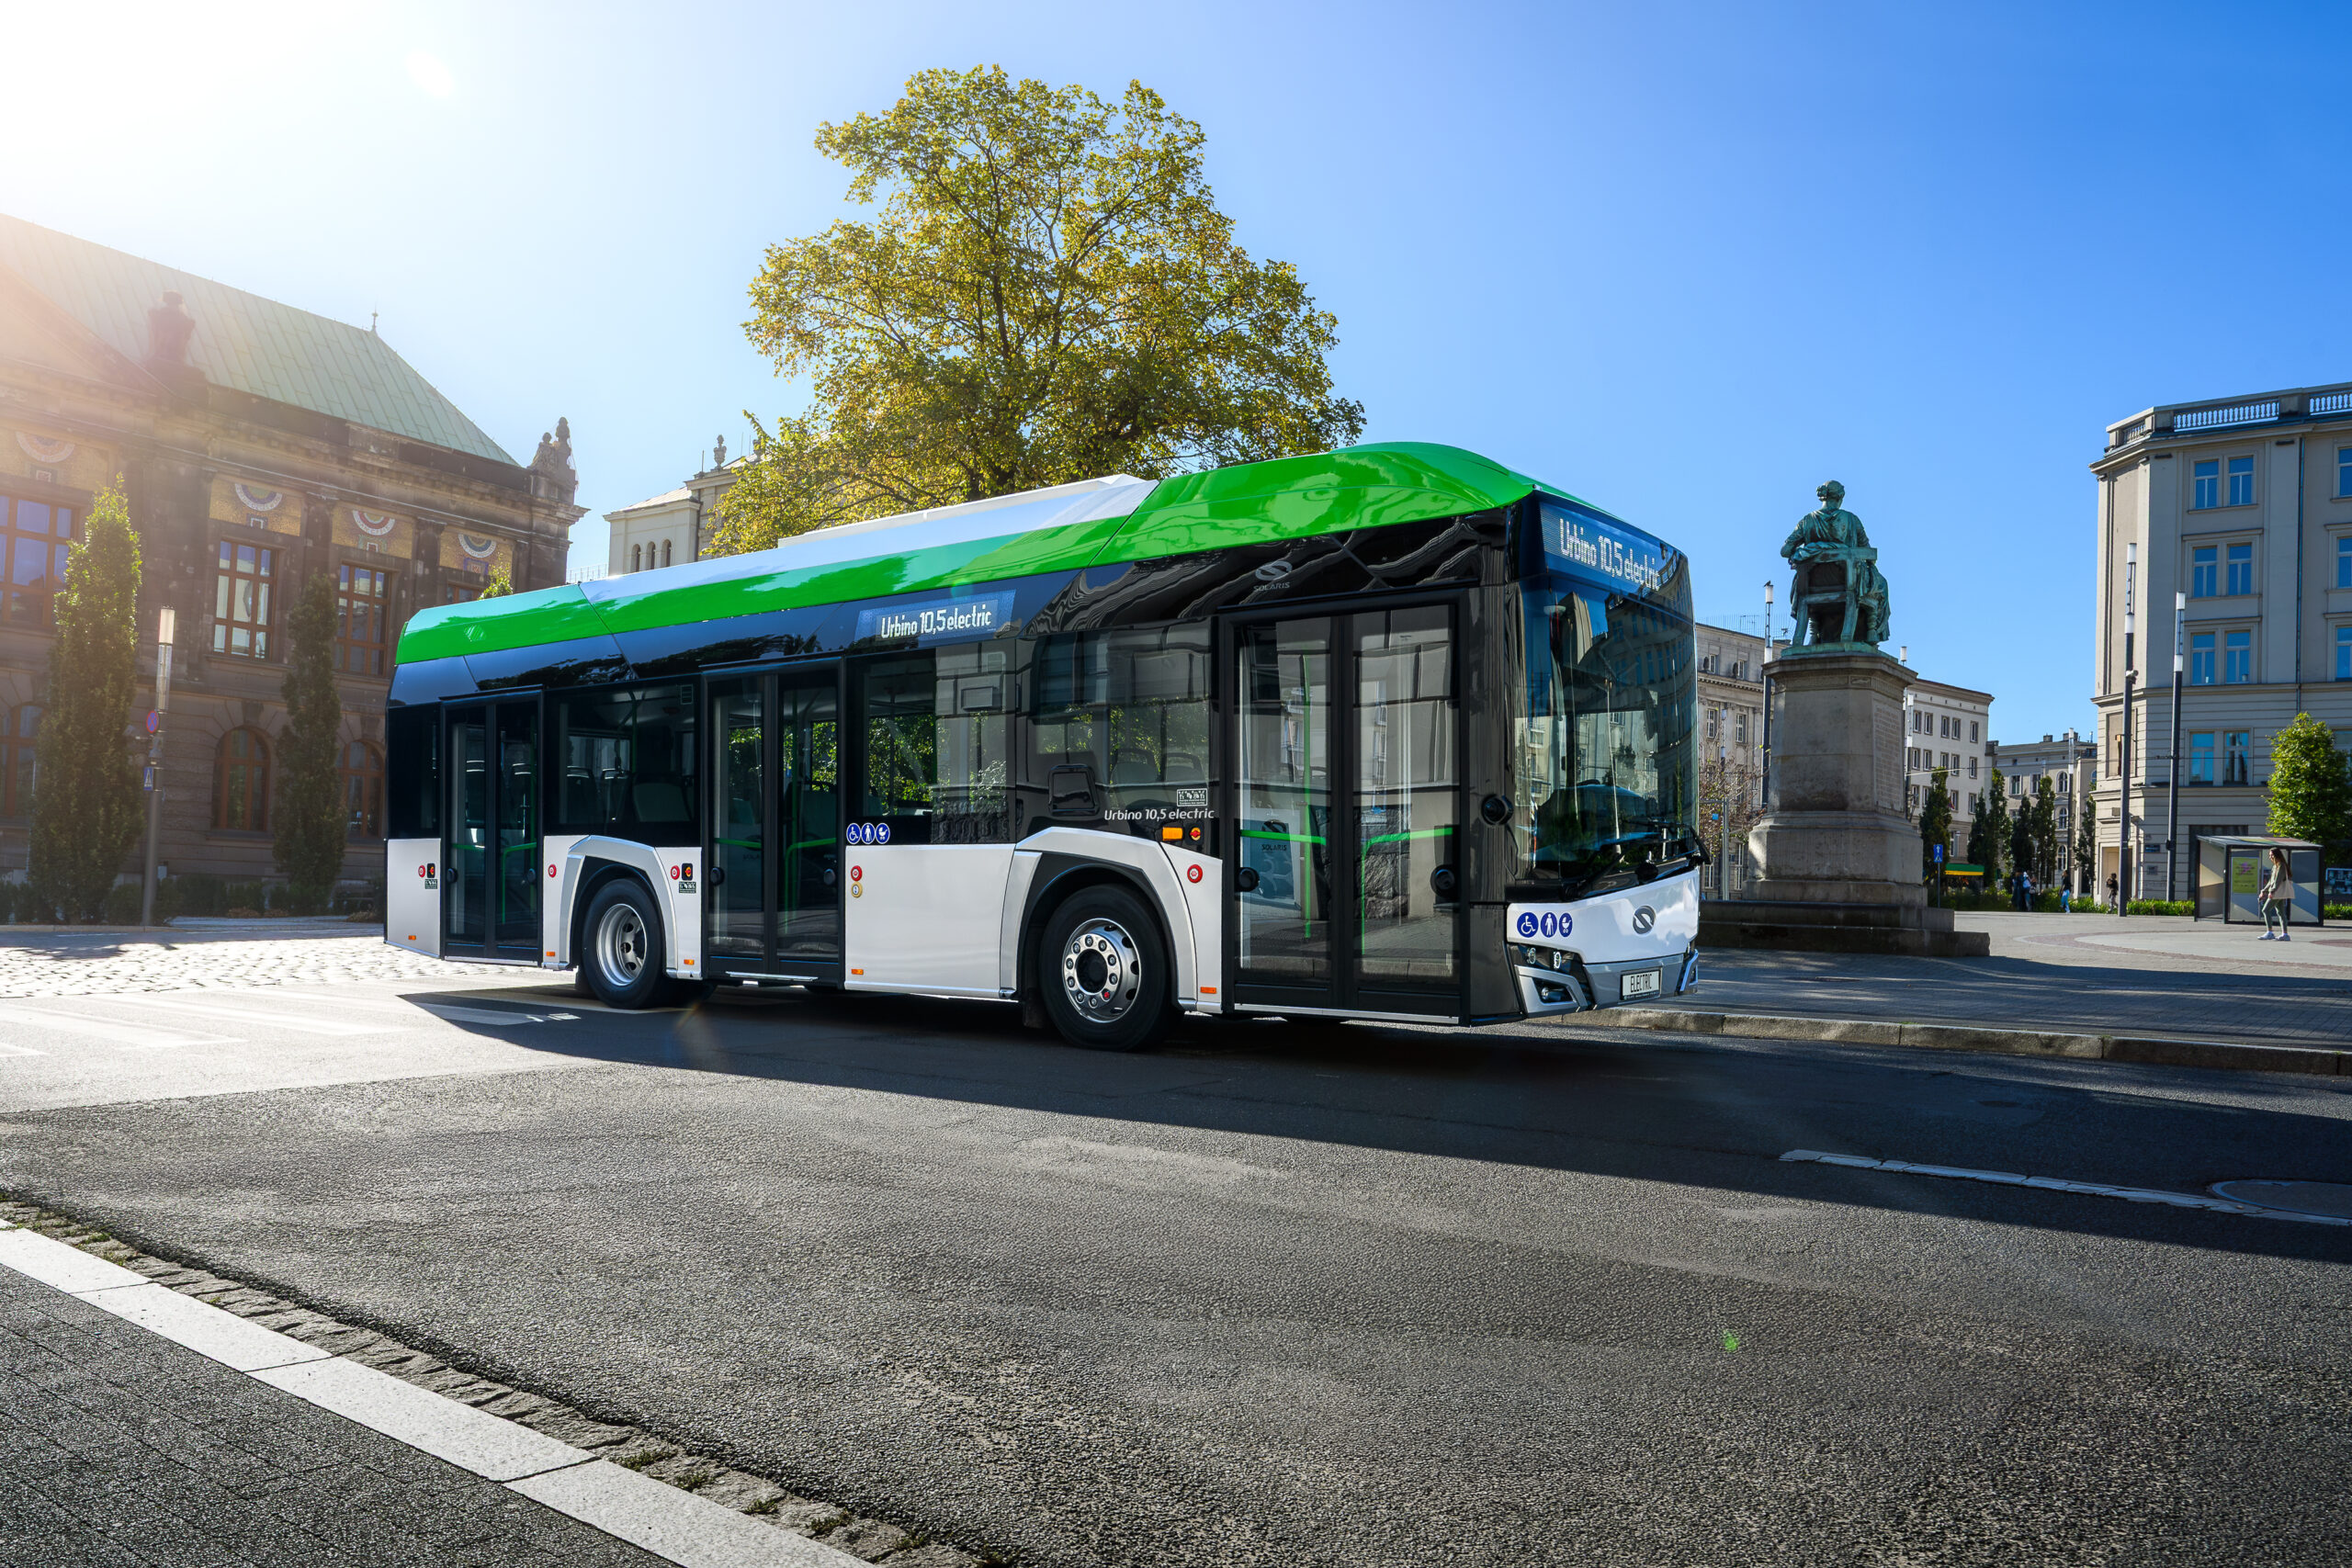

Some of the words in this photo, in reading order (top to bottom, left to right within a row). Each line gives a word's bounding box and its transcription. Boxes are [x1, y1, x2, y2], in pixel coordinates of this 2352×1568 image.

[1559, 518, 1597, 567] Urbino
[1599, 535, 1623, 577] 10,5
[1624, 547, 1660, 592] electric
[1253, 581, 1291, 591] SOLARIS
[881, 615, 918, 638] Urbino
[919, 609, 947, 635] 10,5
[946, 604, 992, 630] electric
[1104, 809, 1142, 820] Urbino
[1145, 808, 1167, 821] 10,5
[1169, 807, 1215, 820] electric
[1261, 844, 1287, 852] SOLARIS
[1630, 973, 1653, 993] ELECTRIC
